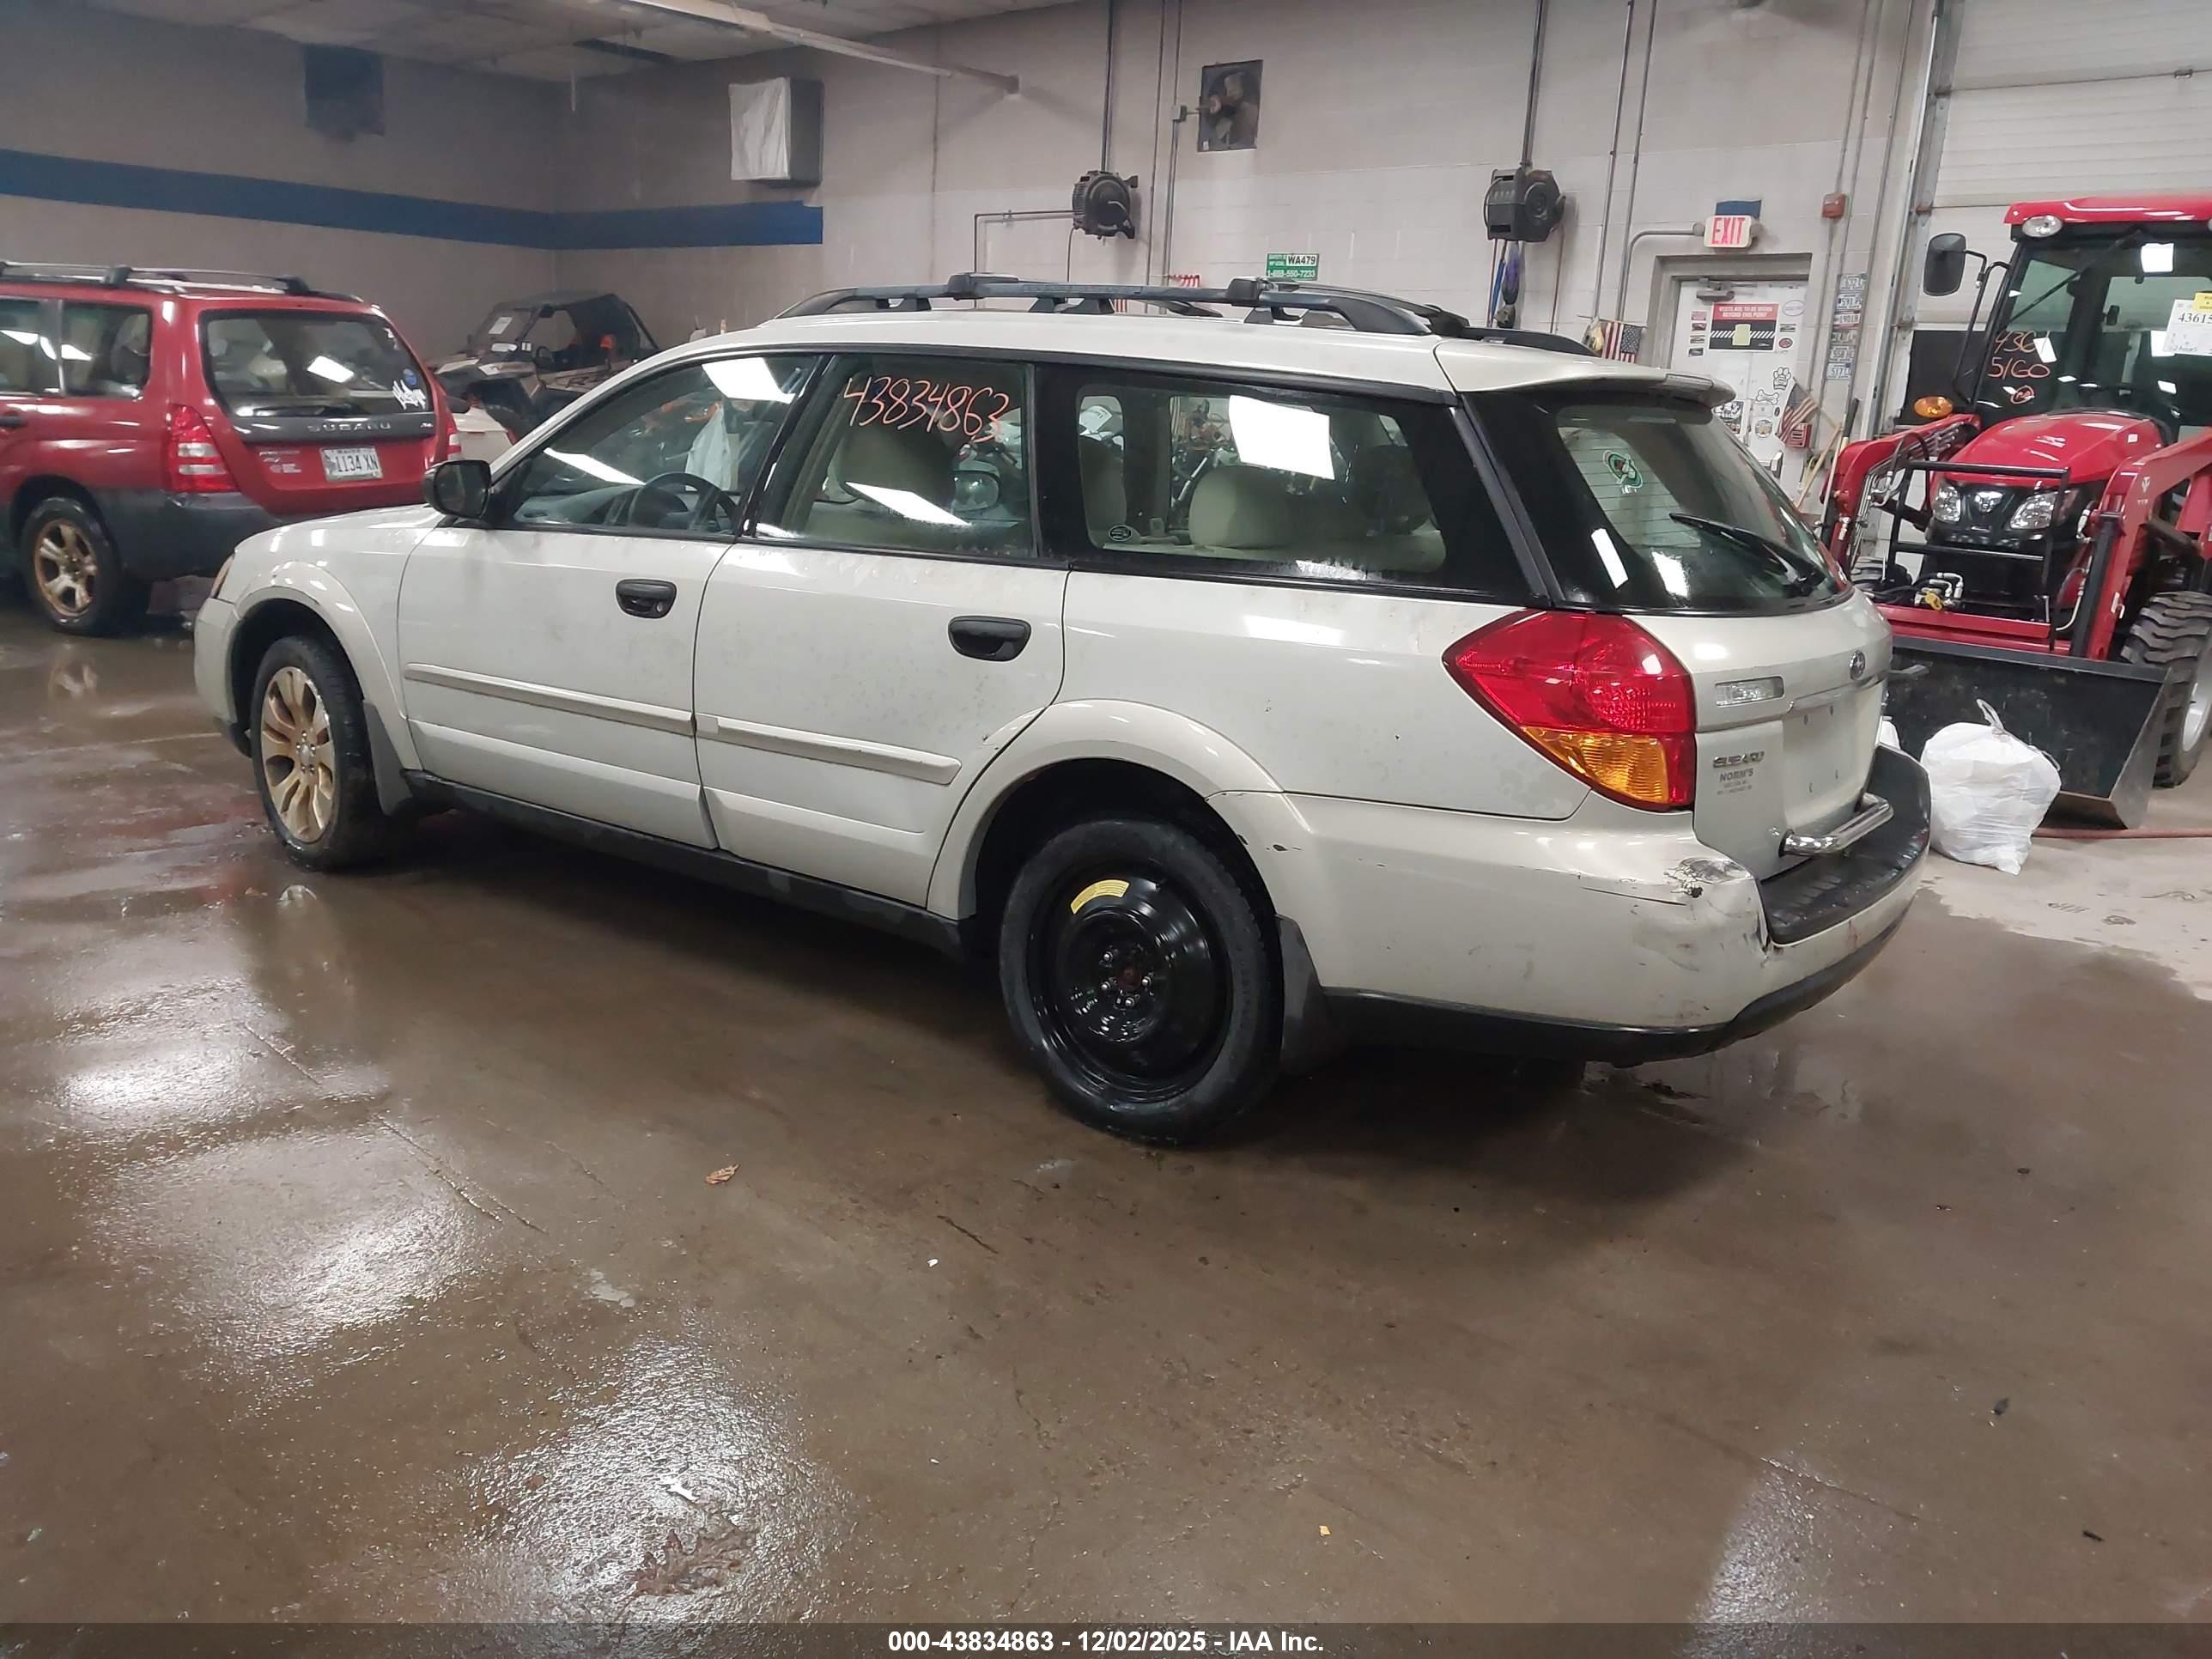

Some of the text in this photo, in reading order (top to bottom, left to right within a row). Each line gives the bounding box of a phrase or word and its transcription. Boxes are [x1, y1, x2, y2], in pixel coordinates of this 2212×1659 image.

[1711, 217, 1746, 245] EXIT
[1288, 255, 1316, 265] WA479
[1988, 356, 2051, 380] 5160
[843, 376, 1010, 443] 43834863
[307, 422, 392, 432] SUBARU
[336, 454, 362, 472] 1134
[1713, 750, 1765, 769] SUBARU
